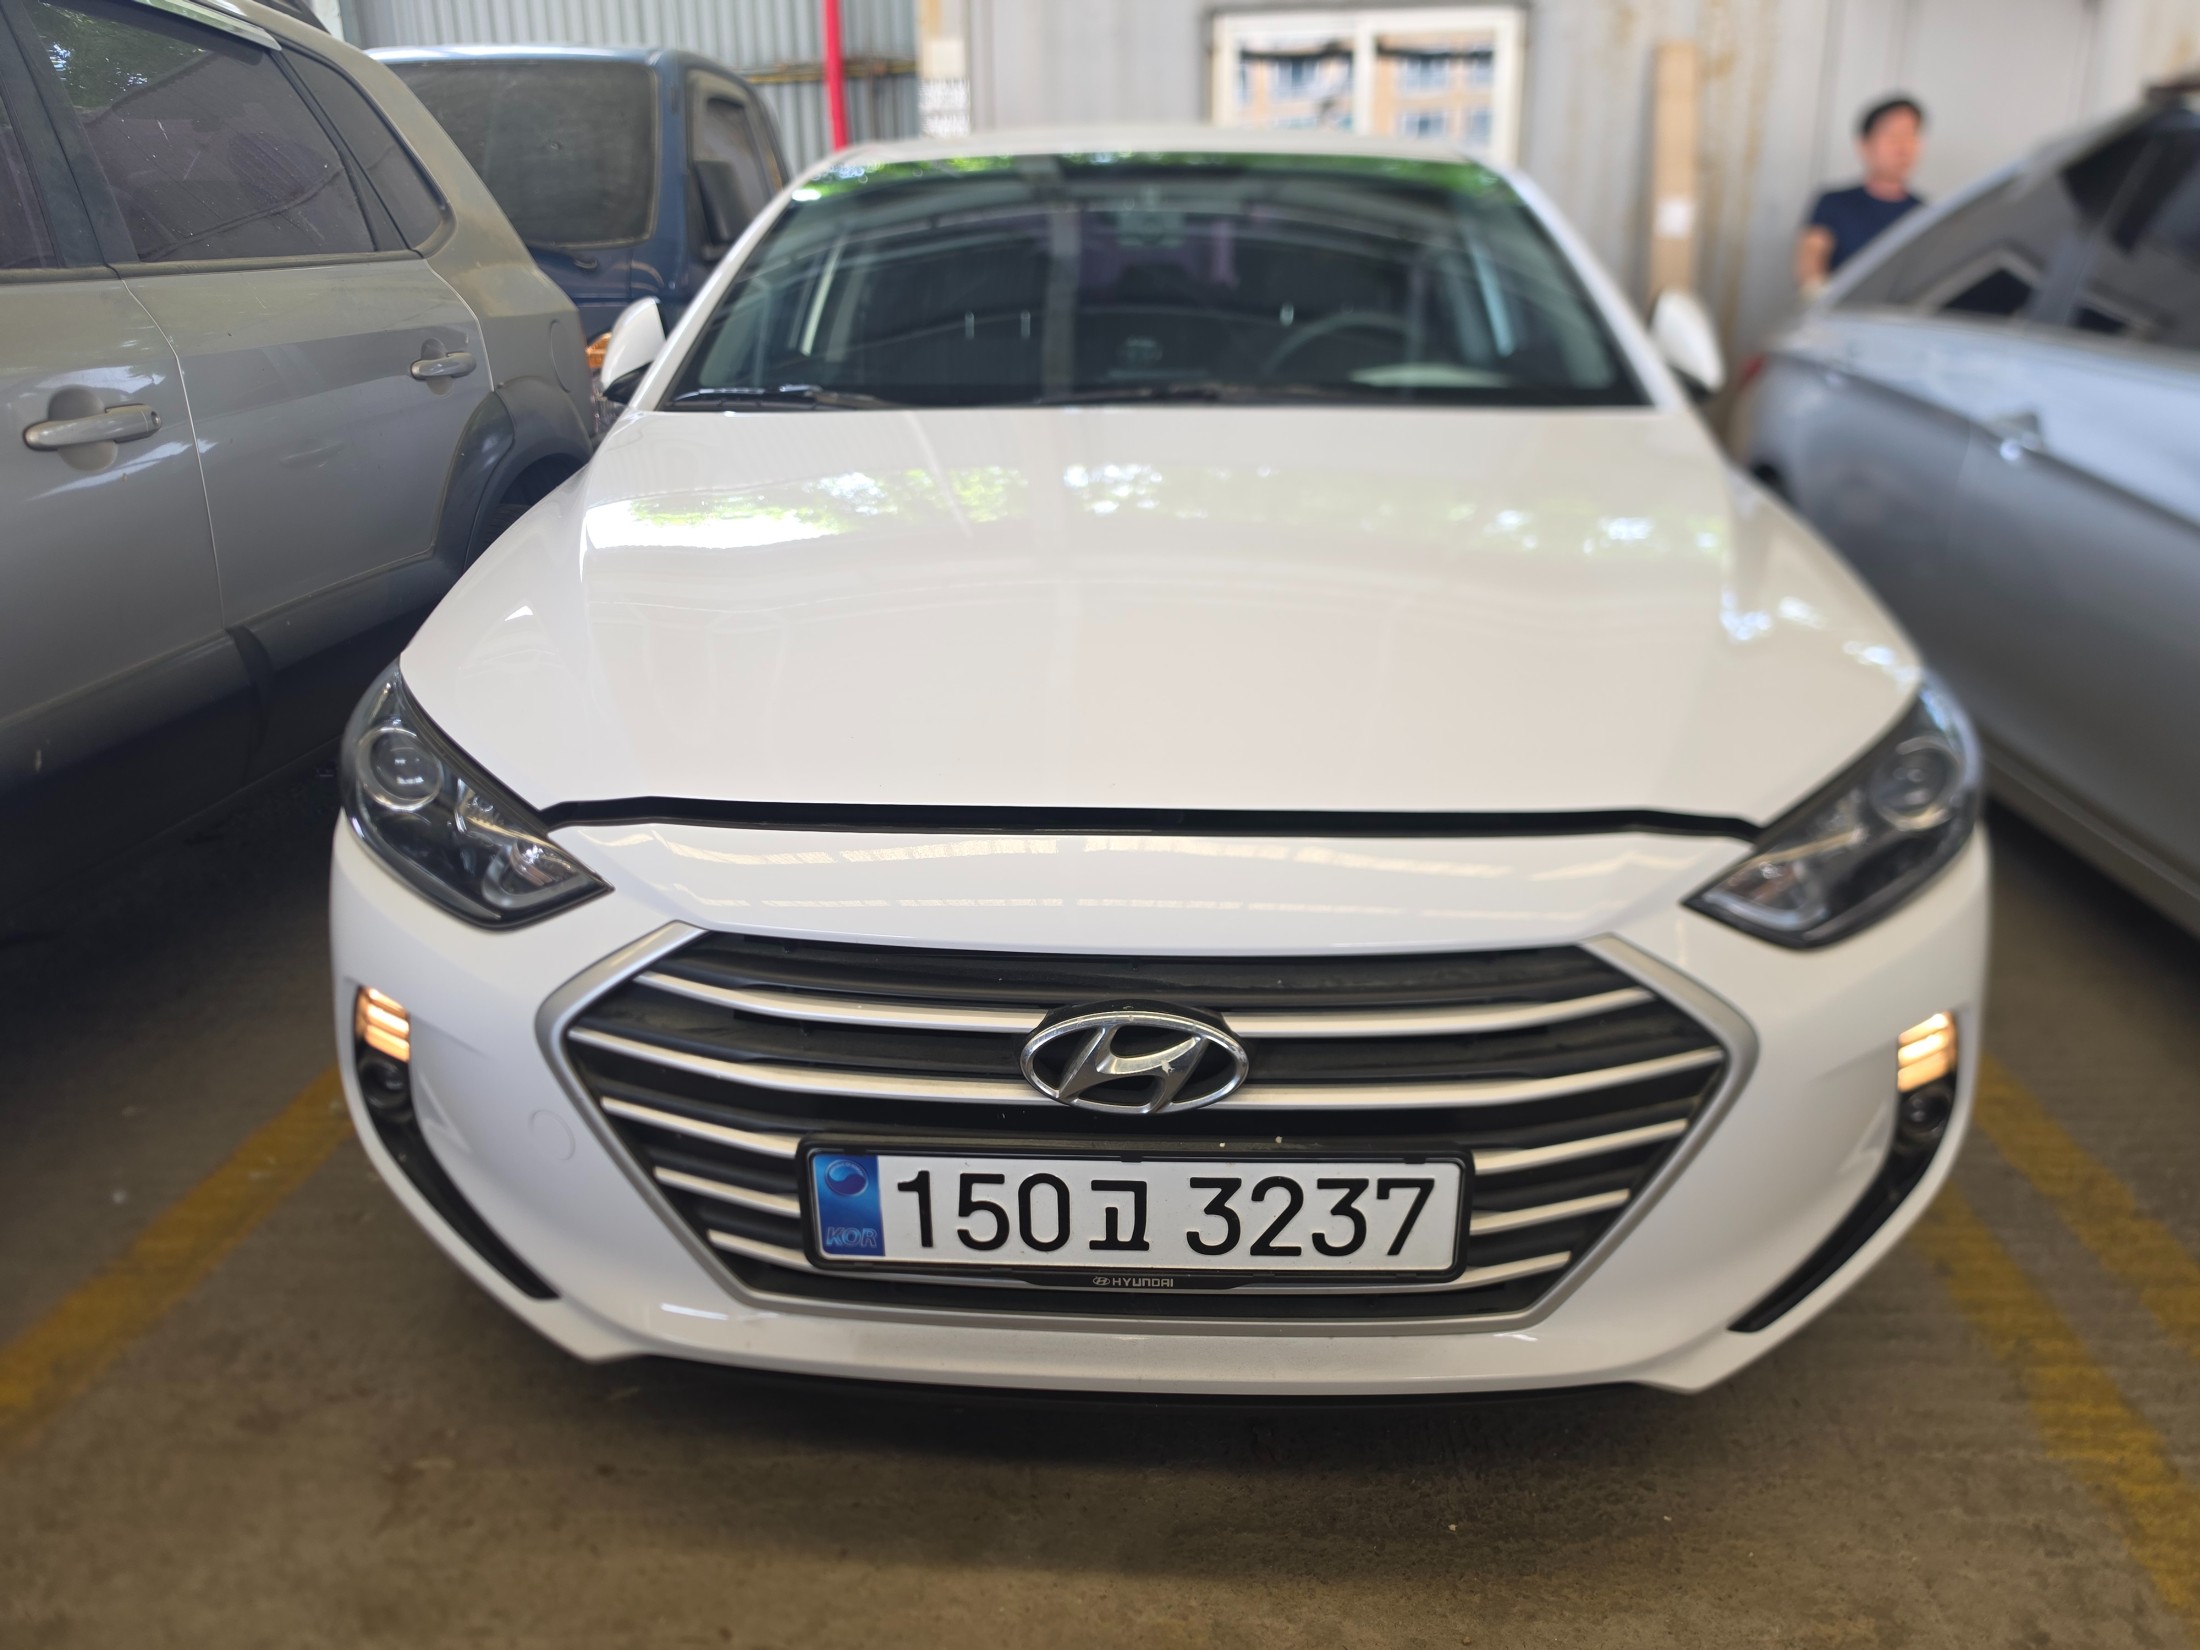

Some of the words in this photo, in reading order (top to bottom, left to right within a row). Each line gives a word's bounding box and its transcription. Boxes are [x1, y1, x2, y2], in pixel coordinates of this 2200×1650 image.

[897, 1170, 1150, 1252] 150고
[1186, 1175, 1436, 1257] 3237
[825, 1226, 878, 1249] KOR
[1112, 1277, 1174, 1288] HYUNDAI
